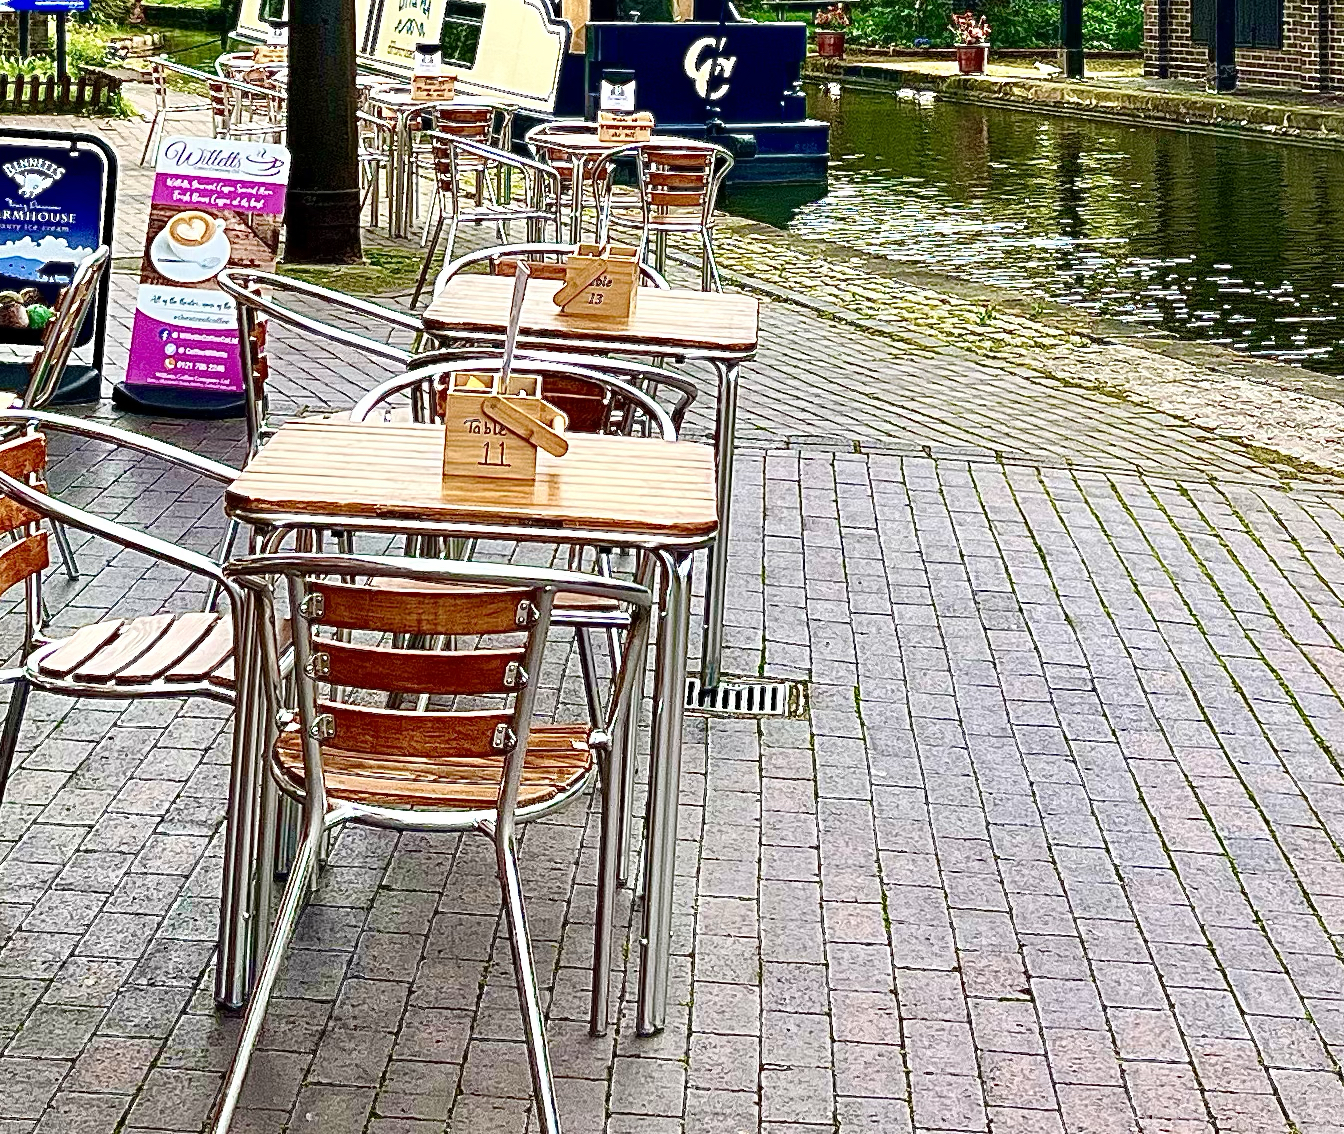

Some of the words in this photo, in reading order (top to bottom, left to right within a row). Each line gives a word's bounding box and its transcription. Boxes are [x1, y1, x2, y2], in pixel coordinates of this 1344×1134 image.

[164, 140, 242, 169] Willetts
[2, 157, 66, 180] BENNETTS
[588, 292, 604, 305] 13
[463, 418, 507, 436] Table
[478, 440, 512, 467] 11
